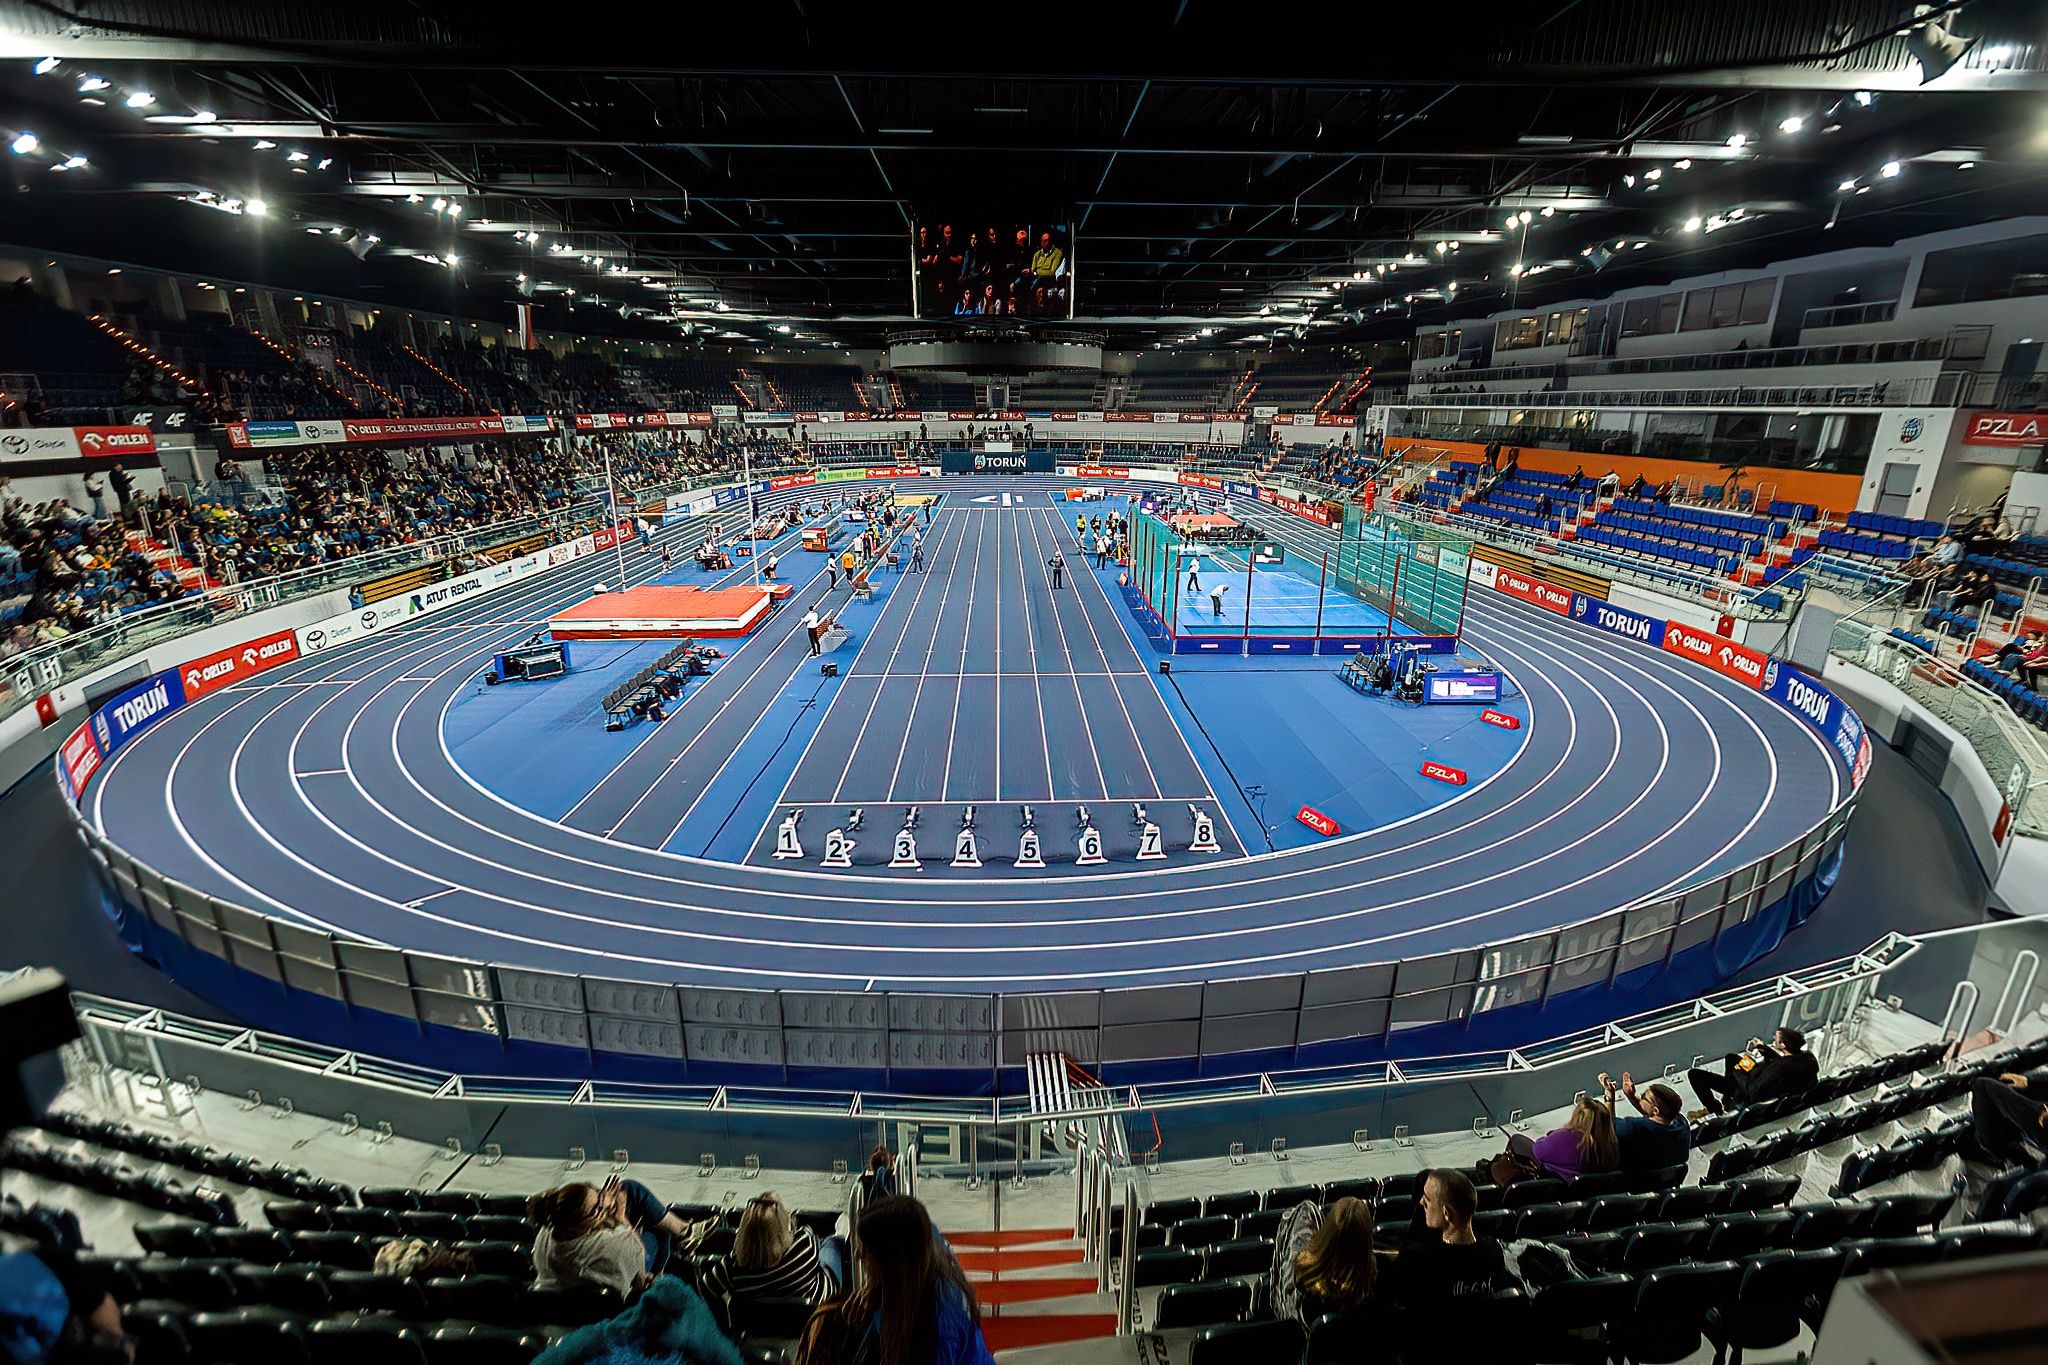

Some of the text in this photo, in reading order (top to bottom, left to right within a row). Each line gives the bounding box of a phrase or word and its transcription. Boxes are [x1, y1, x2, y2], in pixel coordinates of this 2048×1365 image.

[165, 413, 186, 427] 4F
[1974, 419, 2040, 436] PZLA
[359, 425, 381, 435] ORLEN
[107, 433, 149, 446] ORLEN
[986, 455, 1026, 467] TORUŃ
[1233, 483, 1253, 496] TORUŃ
[426, 578, 482, 606] ATUT RENTAL
[1509, 578, 1530, 593] ORLEN
[1546, 590, 1569, 606] ORLEN
[1597, 607, 1651, 640] TORUŃ
[259, 639, 292, 659] ORLEN
[1683, 636, 1712, 656] ORLEN
[202, 658, 235, 680] ORLEN
[1733, 656, 1761, 678] ORLEN
[114, 680, 170, 733] TORUŃ
[1786, 677, 1830, 725] TORUŃ
[1485, 713, 1511, 726] PZLA
[1426, 765, 1458, 781] PZLA
[1301, 810, 1327, 831] PZLA
[782, 825, 1210, 858] 1 2 3 4 5 6 7 8
